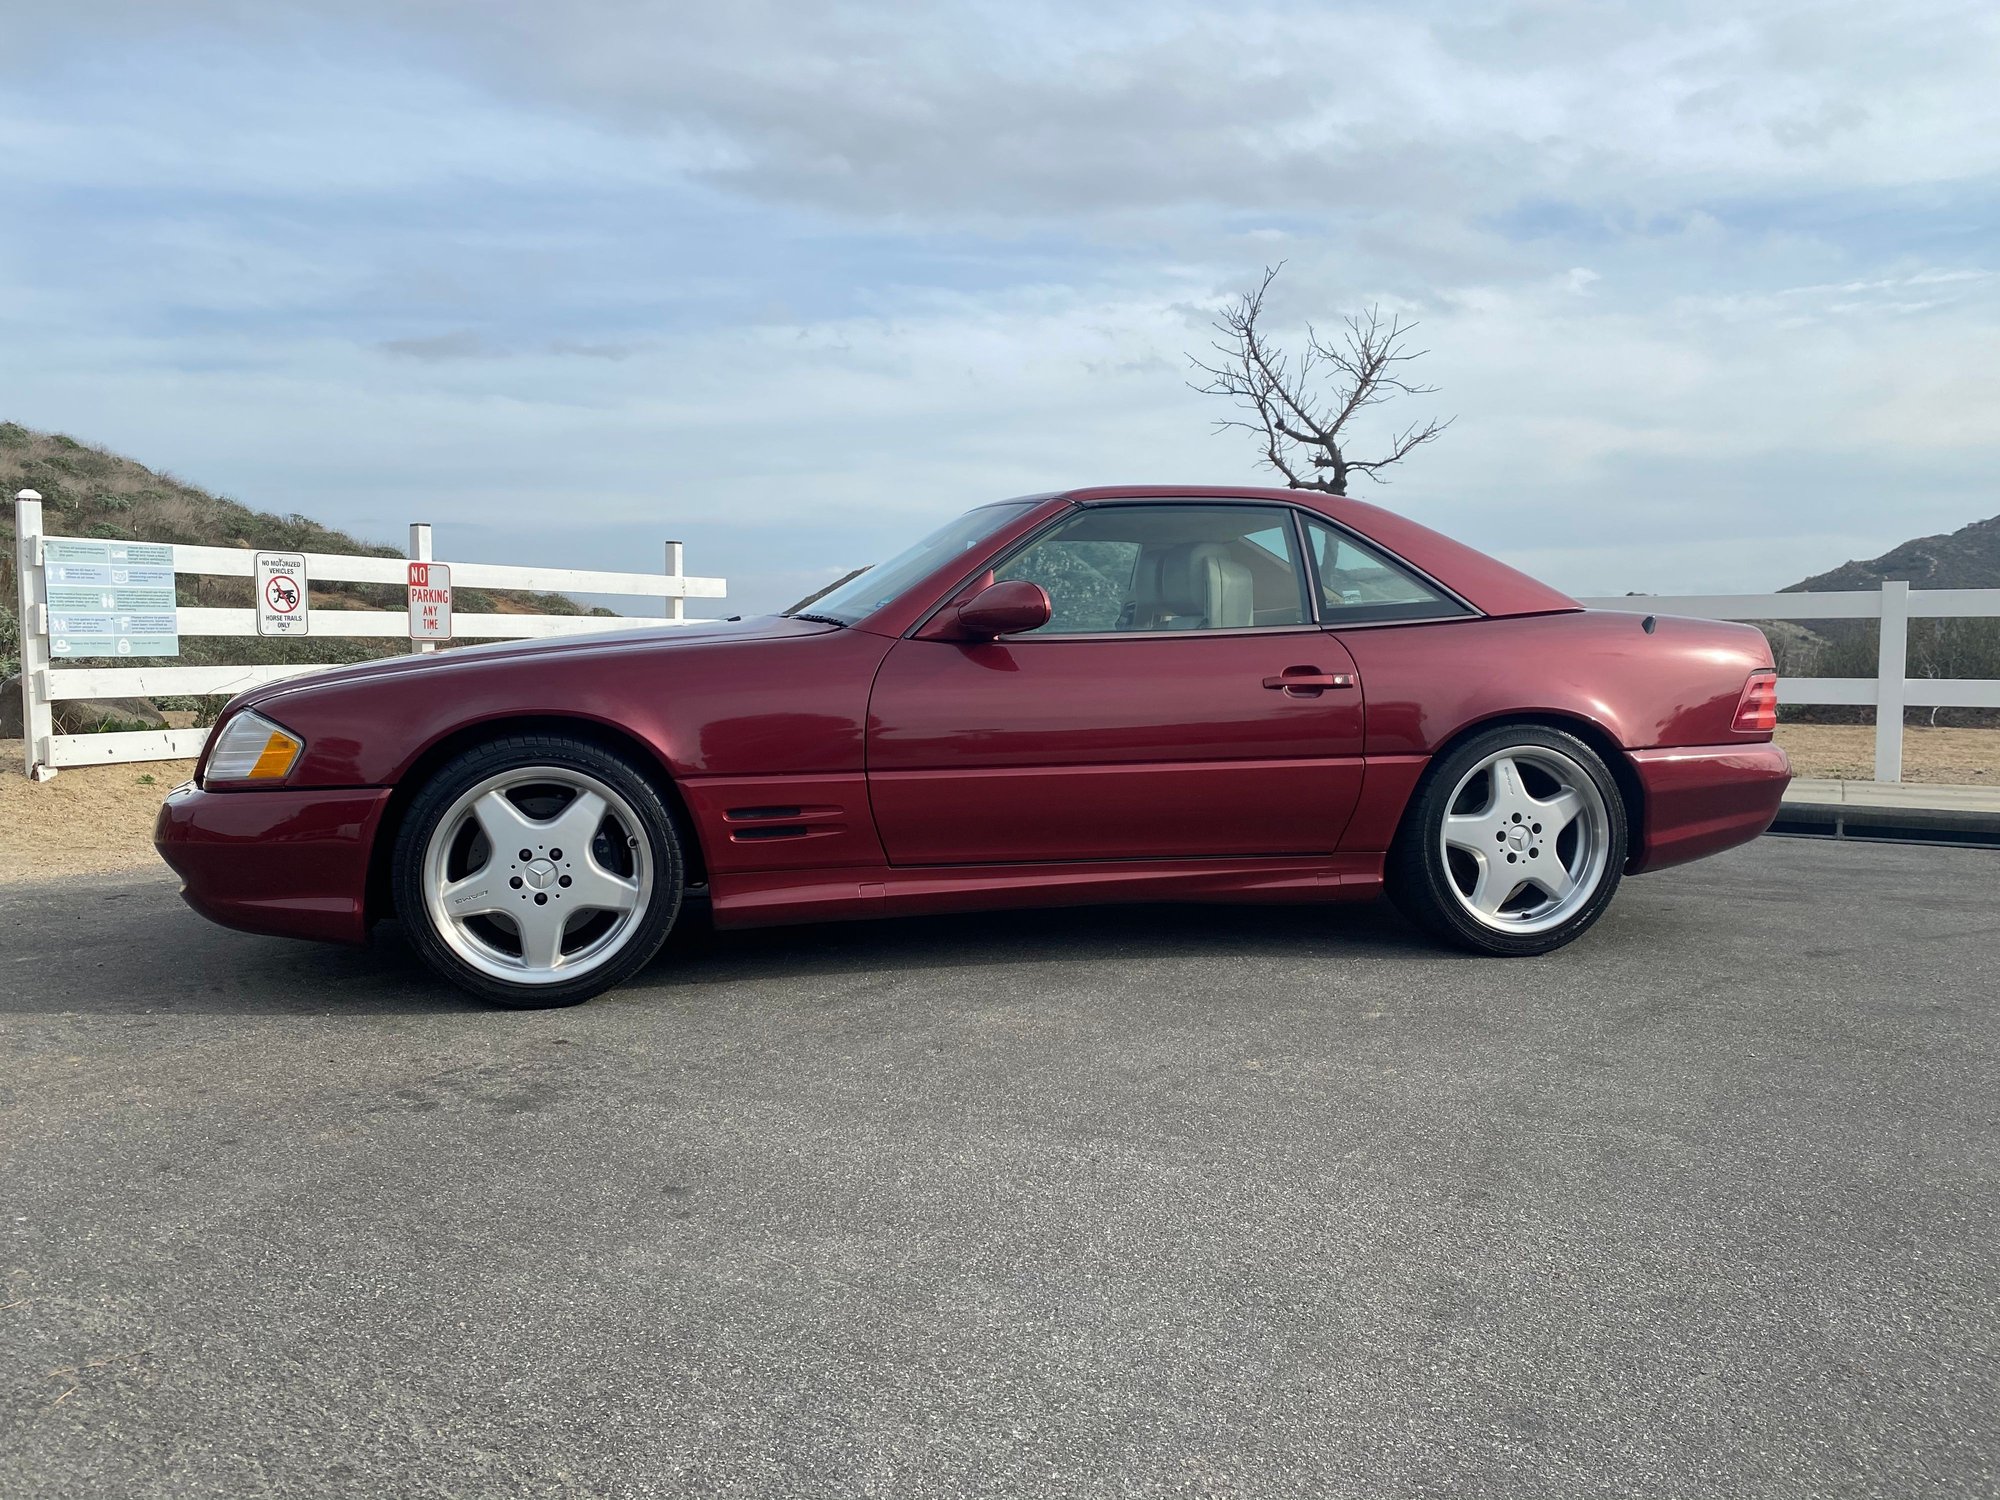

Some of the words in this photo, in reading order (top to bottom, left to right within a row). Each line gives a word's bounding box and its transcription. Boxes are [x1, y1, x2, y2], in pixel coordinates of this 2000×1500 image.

[411, 566, 426, 583] NO
[412, 588, 448, 604] PARKING
[423, 606, 438, 616] ANY
[423, 619, 438, 629] TIME
